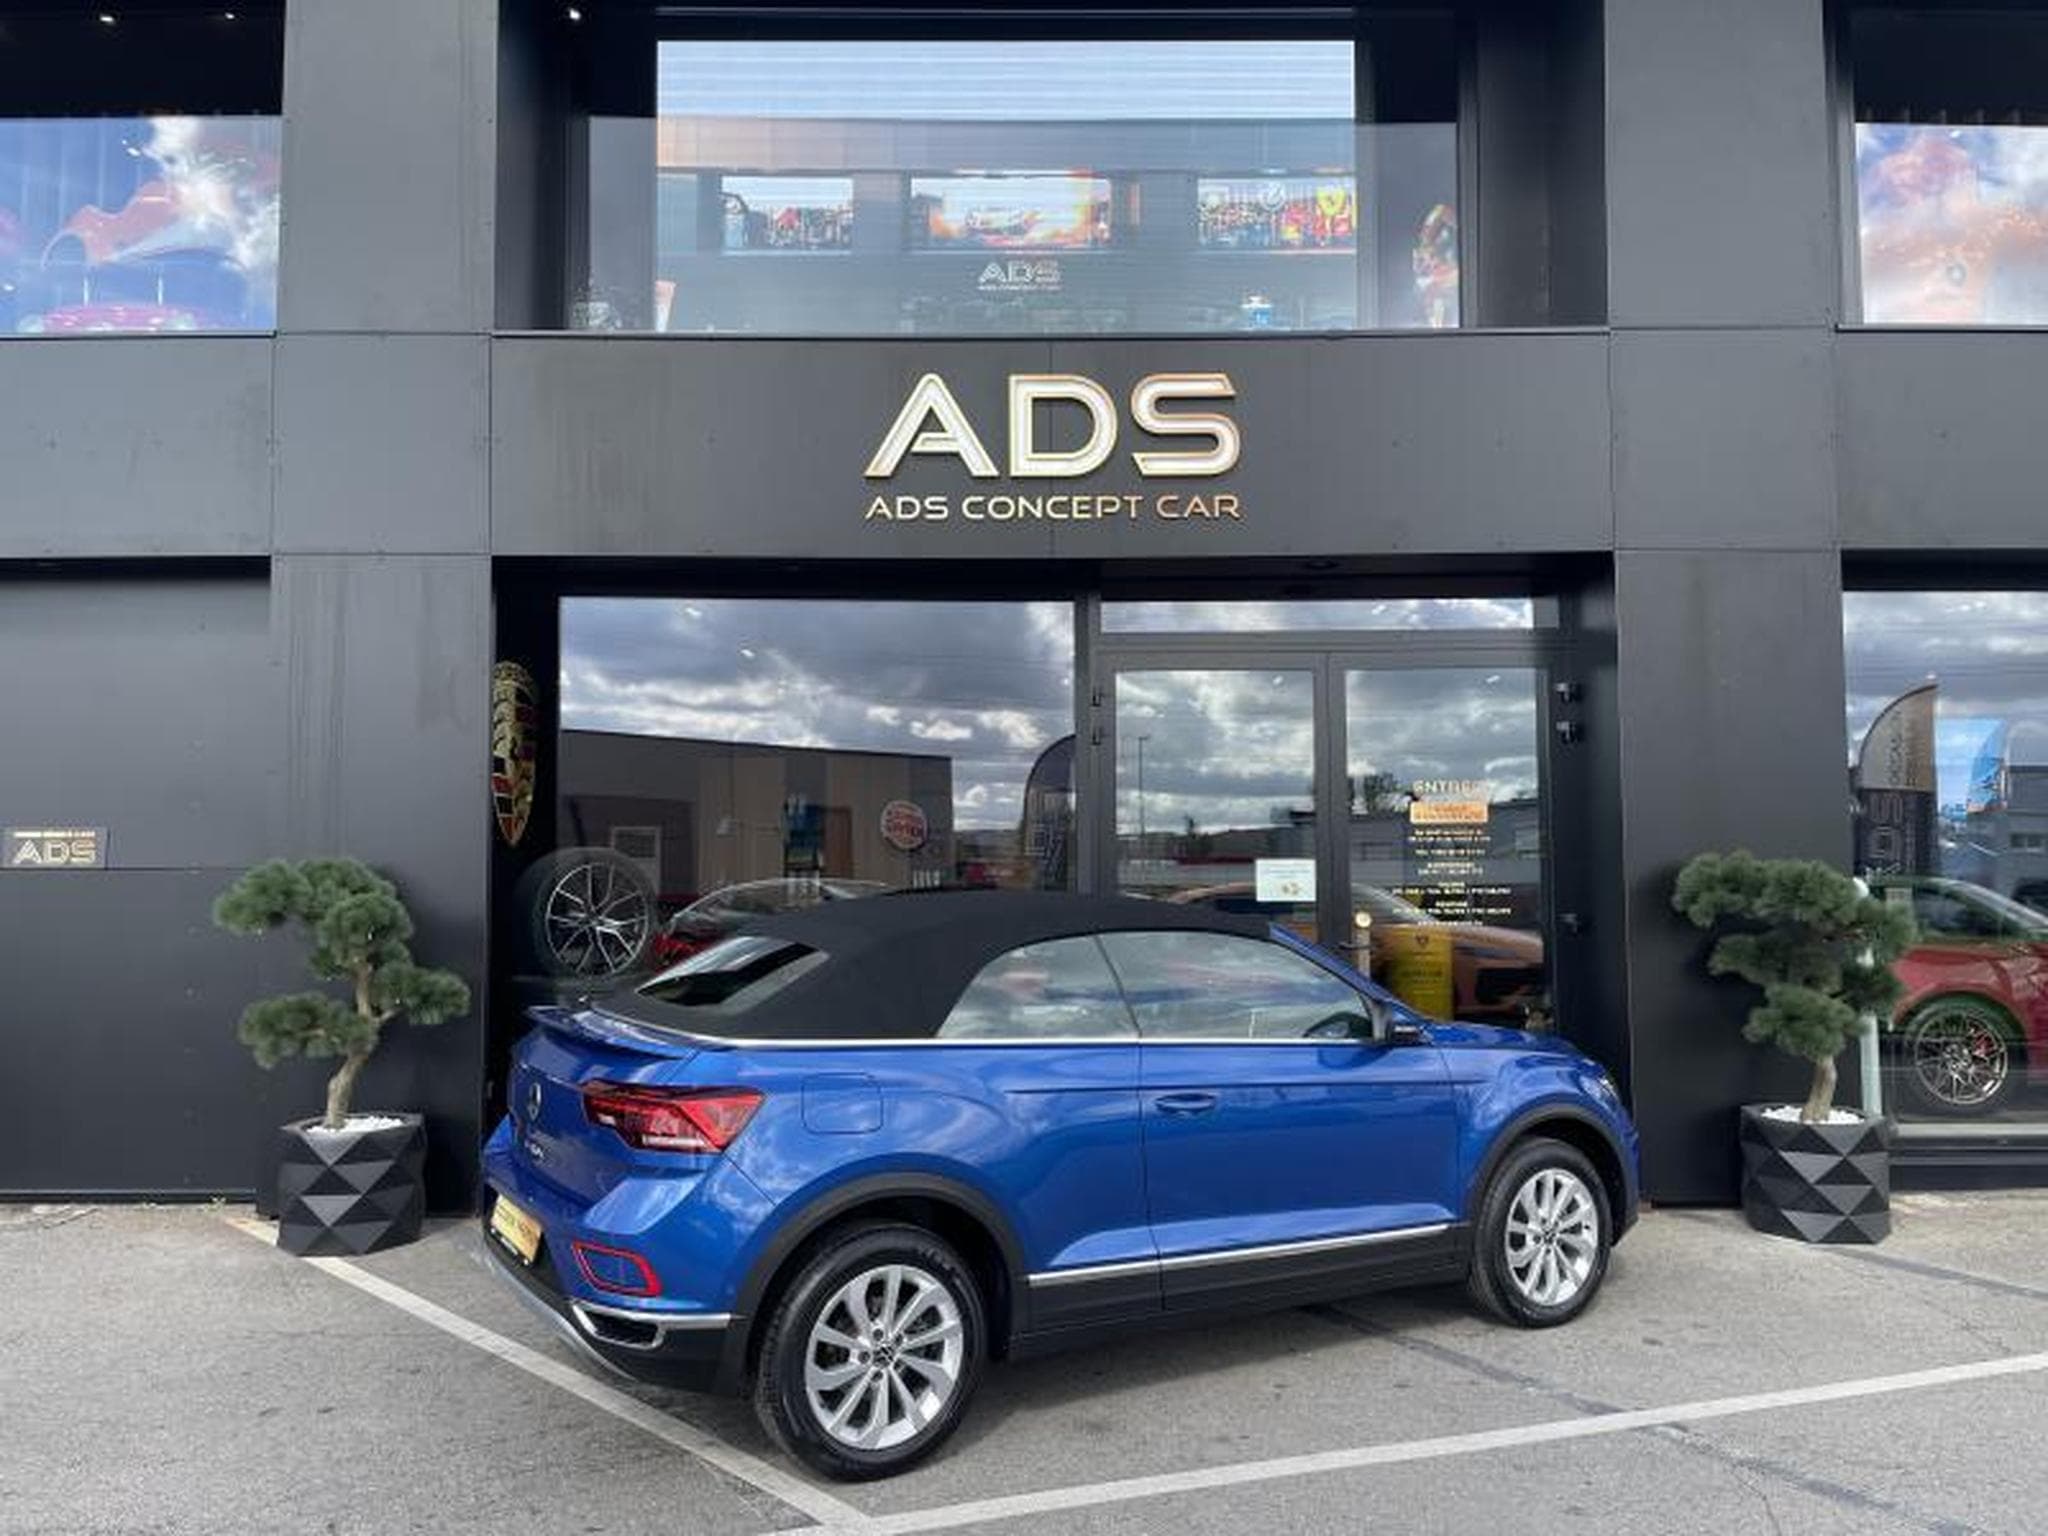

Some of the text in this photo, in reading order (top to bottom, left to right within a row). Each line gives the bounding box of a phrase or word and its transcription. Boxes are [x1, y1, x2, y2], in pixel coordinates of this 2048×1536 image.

[863, 372, 1241, 478] ADS
[865, 495, 1241, 520] ADS CONCEPT CAR
[13, 839, 96, 864] ADS
